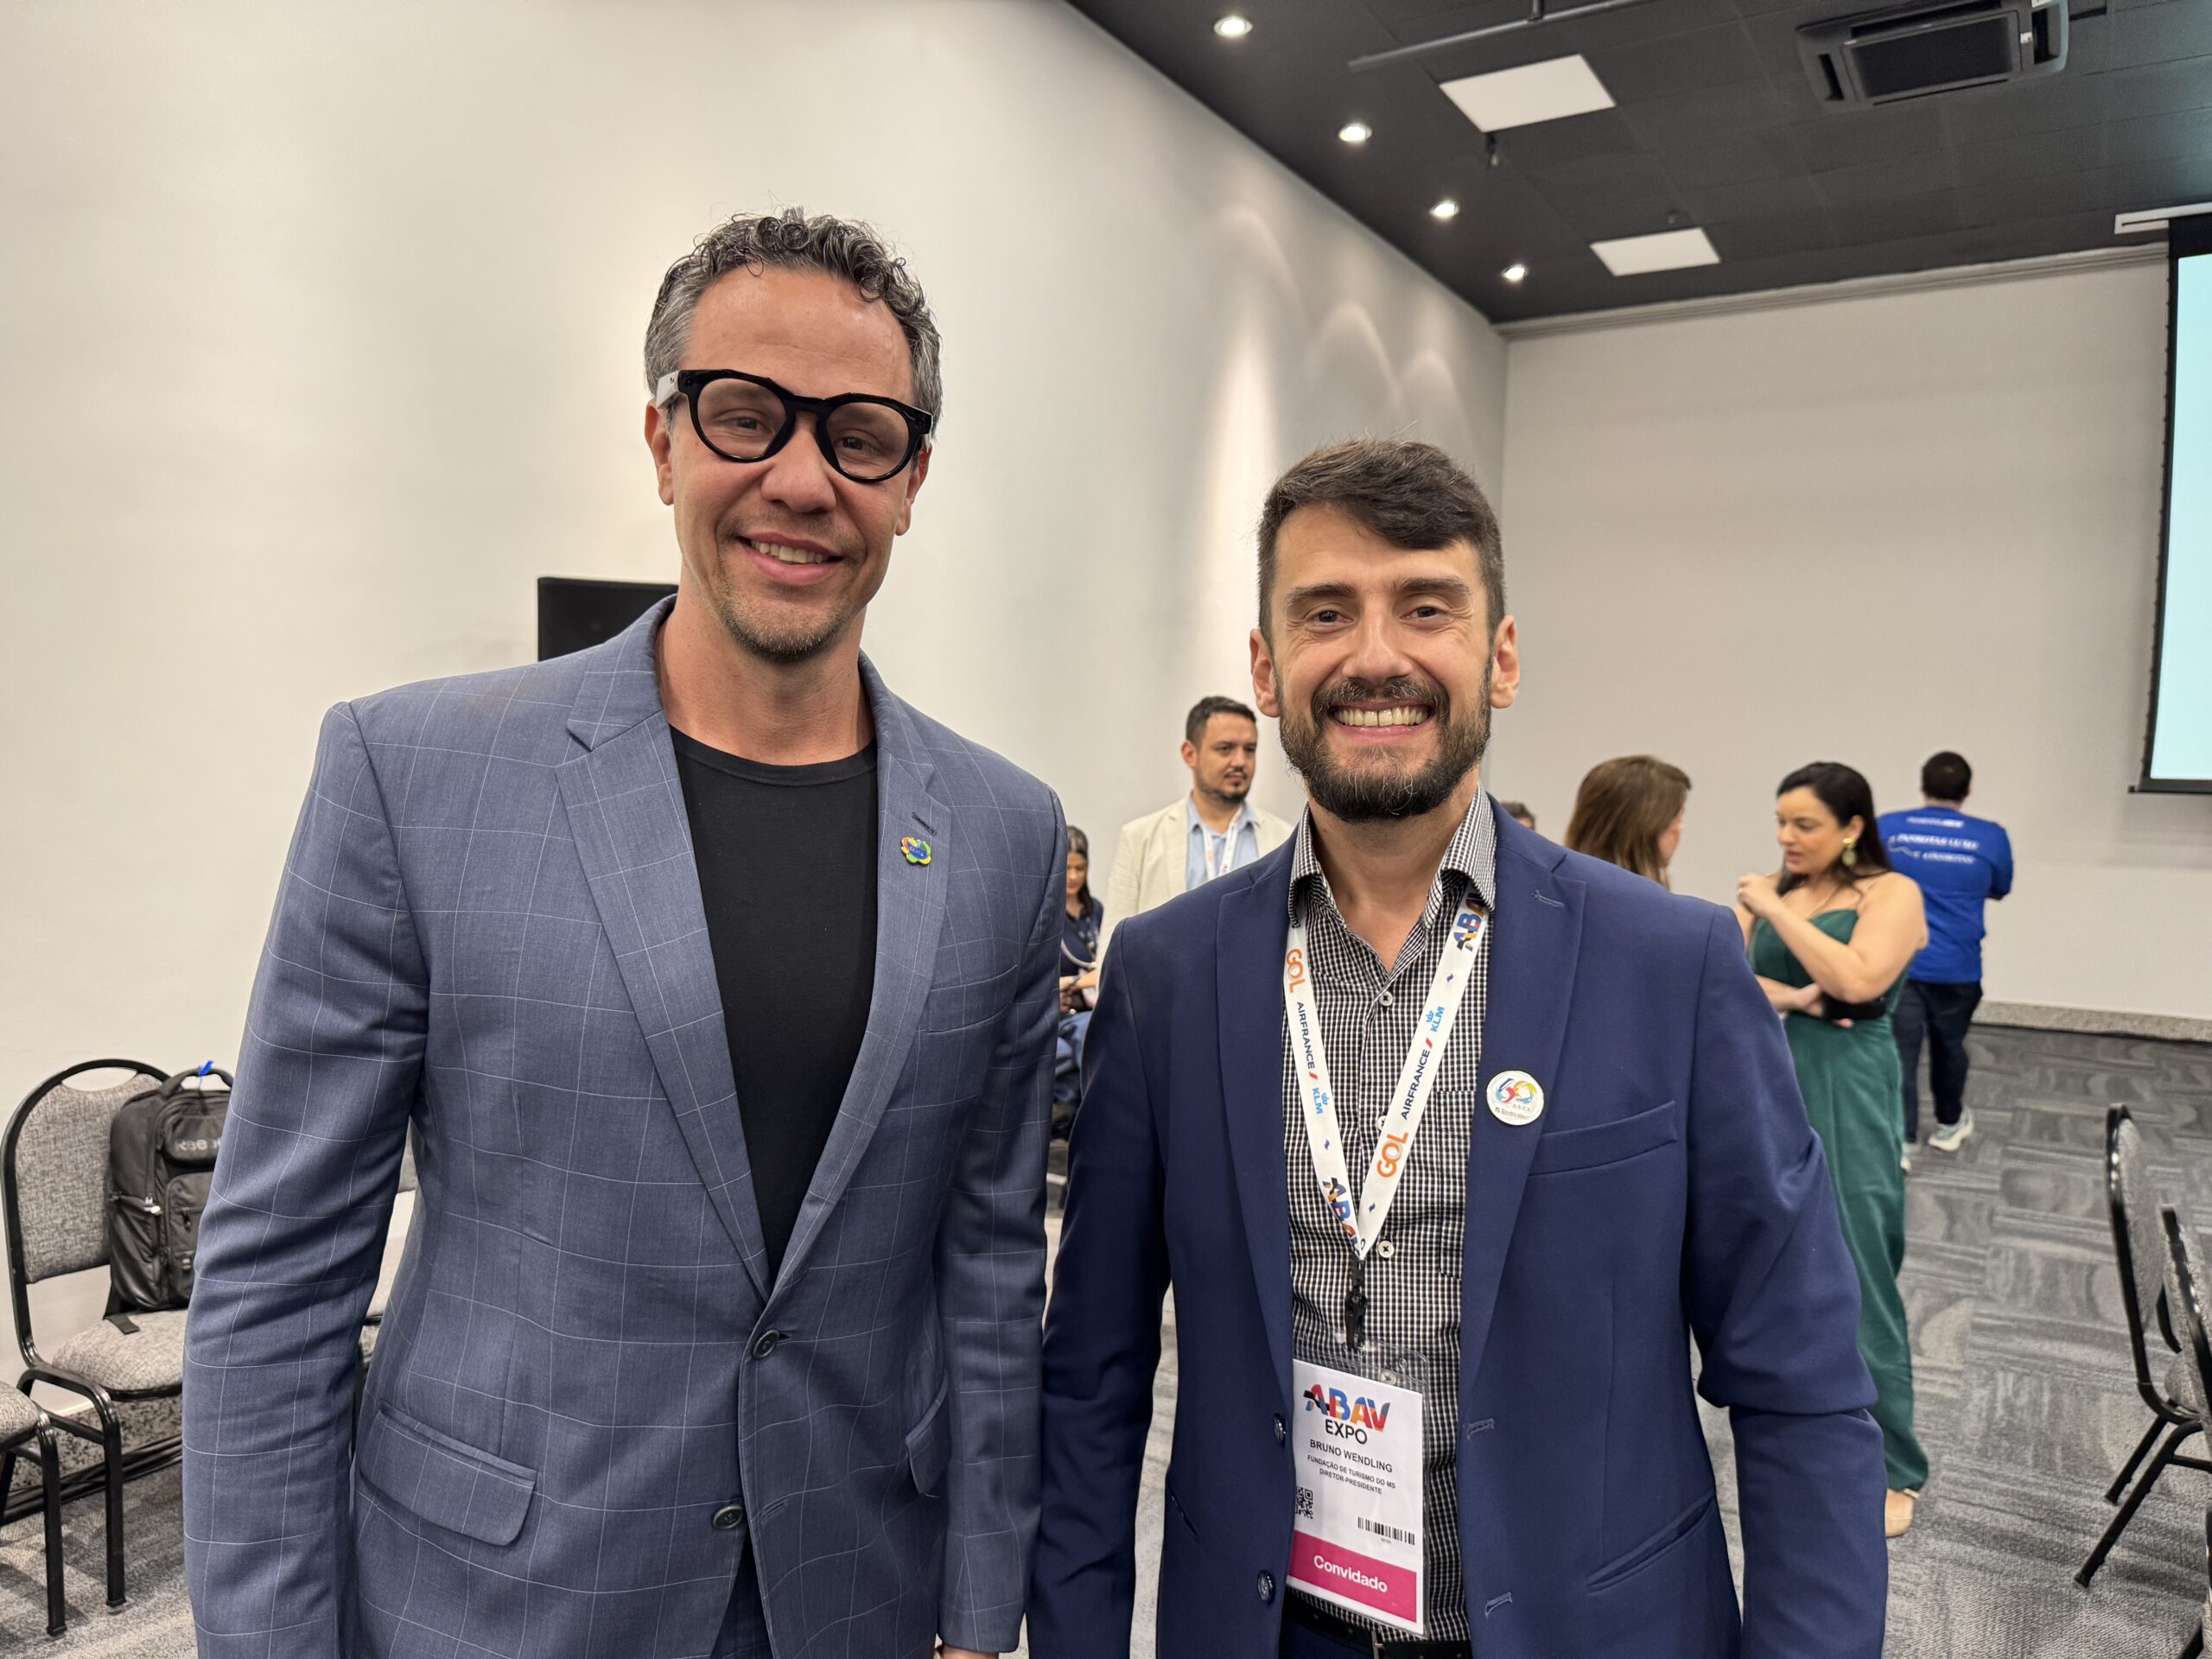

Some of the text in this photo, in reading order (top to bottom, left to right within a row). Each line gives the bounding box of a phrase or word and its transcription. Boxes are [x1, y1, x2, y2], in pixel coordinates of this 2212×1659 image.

[1286, 949, 1306, 993] GOL
[1297, 1002, 1315, 1069] AIRFRANCE
[1313, 1088, 1324, 1115] KLM
[1376, 1132, 1409, 1178] GOL
[1401, 1049, 1430, 1120] AIRFRANCE
[1430, 1006, 1445, 1033] KLM
[1303, 1383, 1391, 1432] ABAV
[1325, 1419, 1368, 1445] EXPO
[1307, 1454, 1395, 1490] FUNDAÇÃO DE TURISMO DO MS
[1310, 1439, 1393, 1472] BRUNO WENDLING
[1319, 1468, 1382, 1495] DIRETOR-PRESIDENTE
[1313, 1554, 1388, 1592] Convidado
